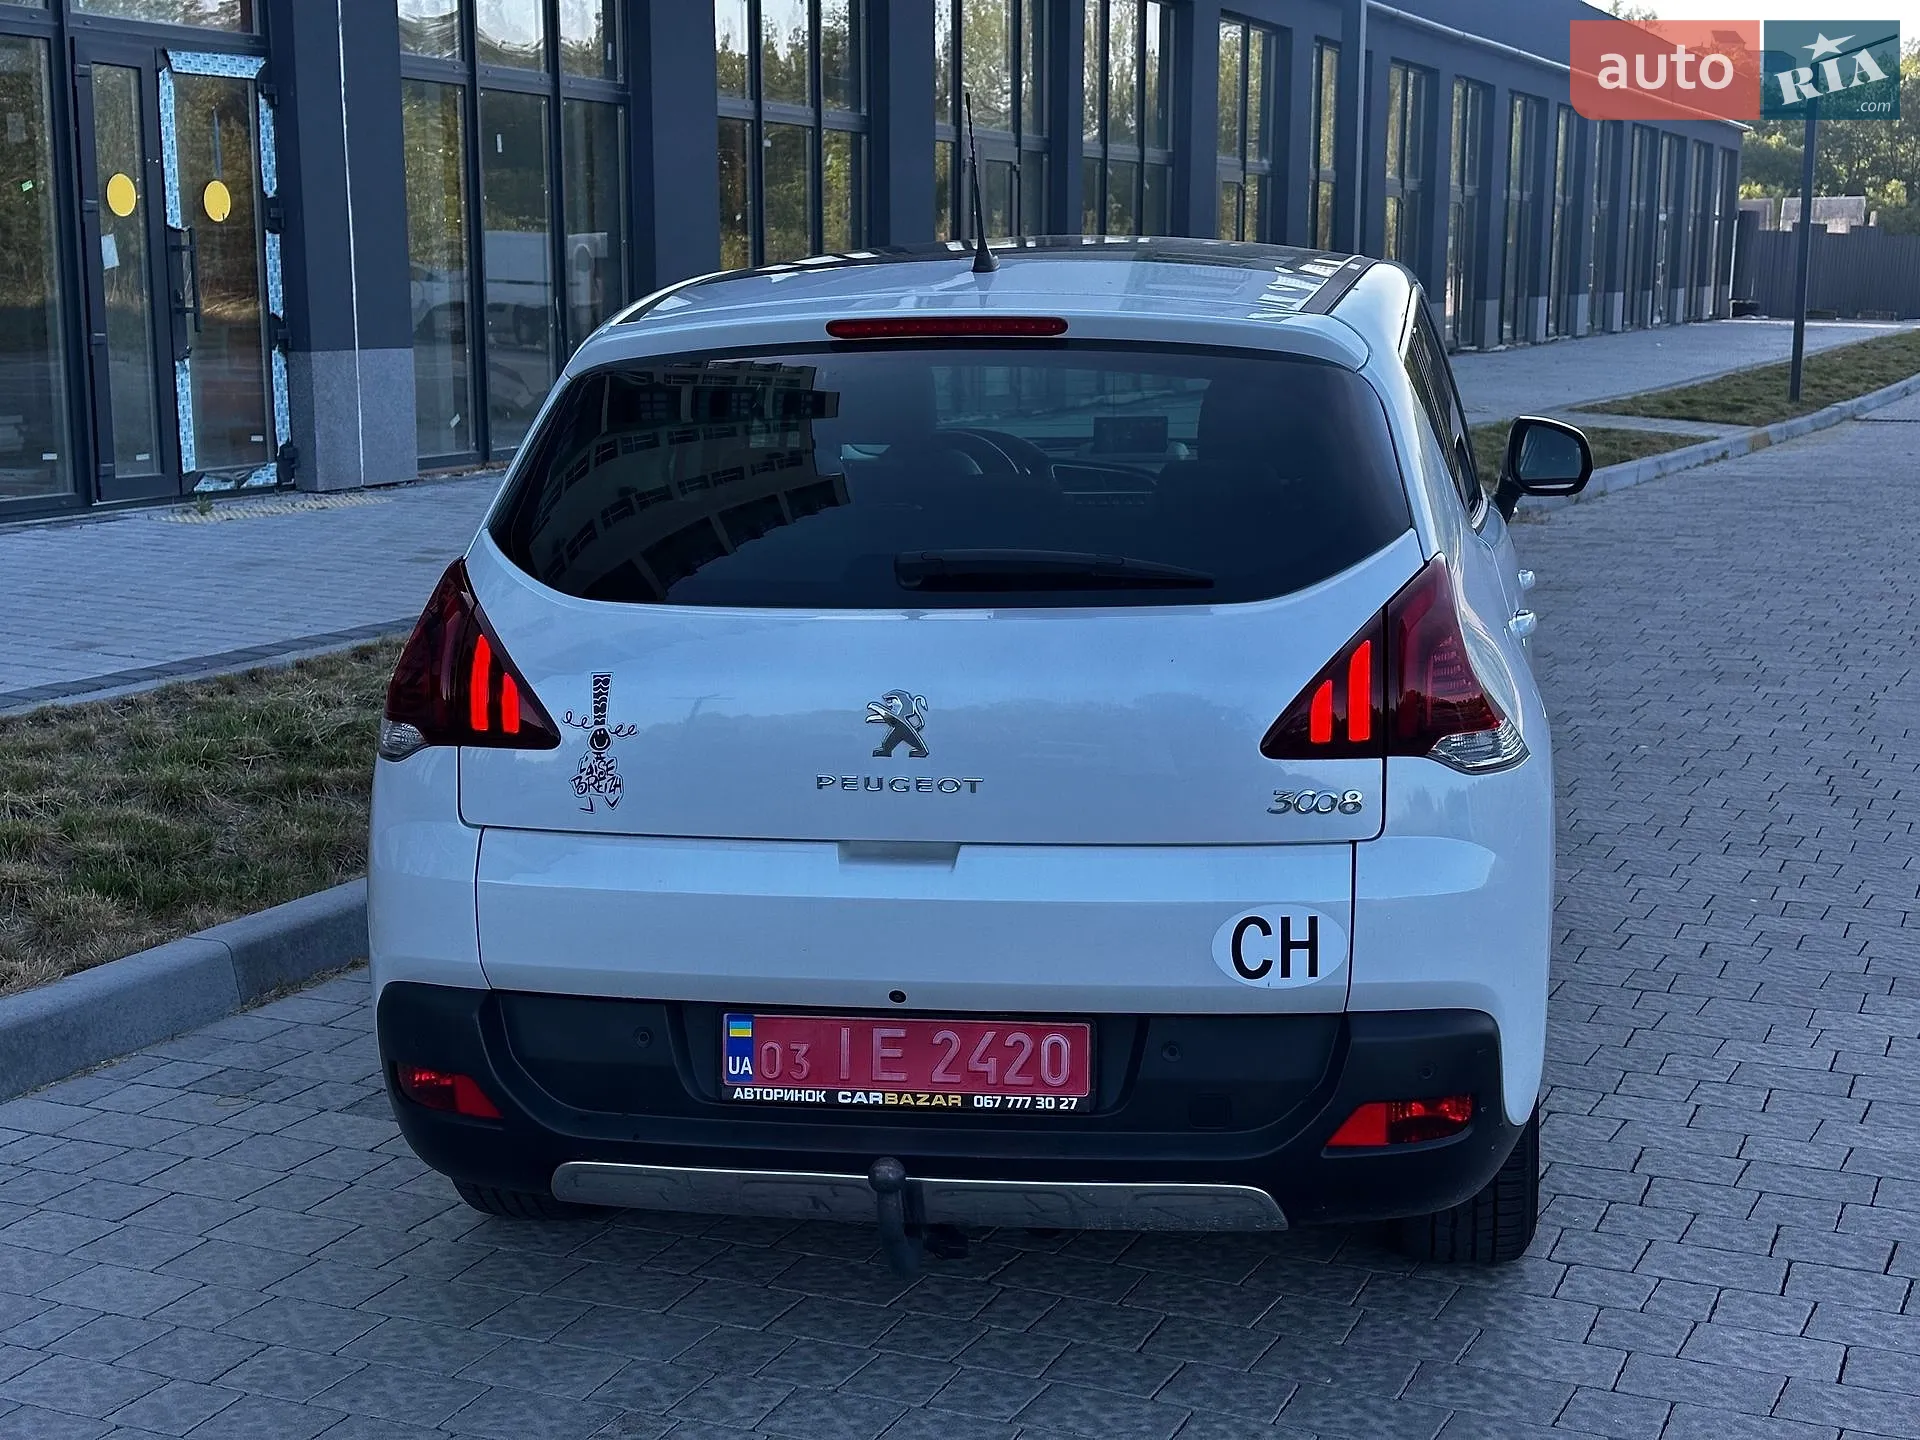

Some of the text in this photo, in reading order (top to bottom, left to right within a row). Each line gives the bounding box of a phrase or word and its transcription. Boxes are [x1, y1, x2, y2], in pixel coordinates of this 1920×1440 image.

[816, 774, 984, 793] PEUGEOT
[1266, 789, 1364, 815] 3008
[1231, 915, 1319, 980] CH
[728, 1056, 753, 1075] UA
[760, 1026, 1071, 1087] 03 IE 2420
[733, 1087, 826, 1103] АВТОРИНОК
[837, 1091, 962, 1107] CARBAZAR
[973, 1095, 1078, 1110] 067 777 30 27
